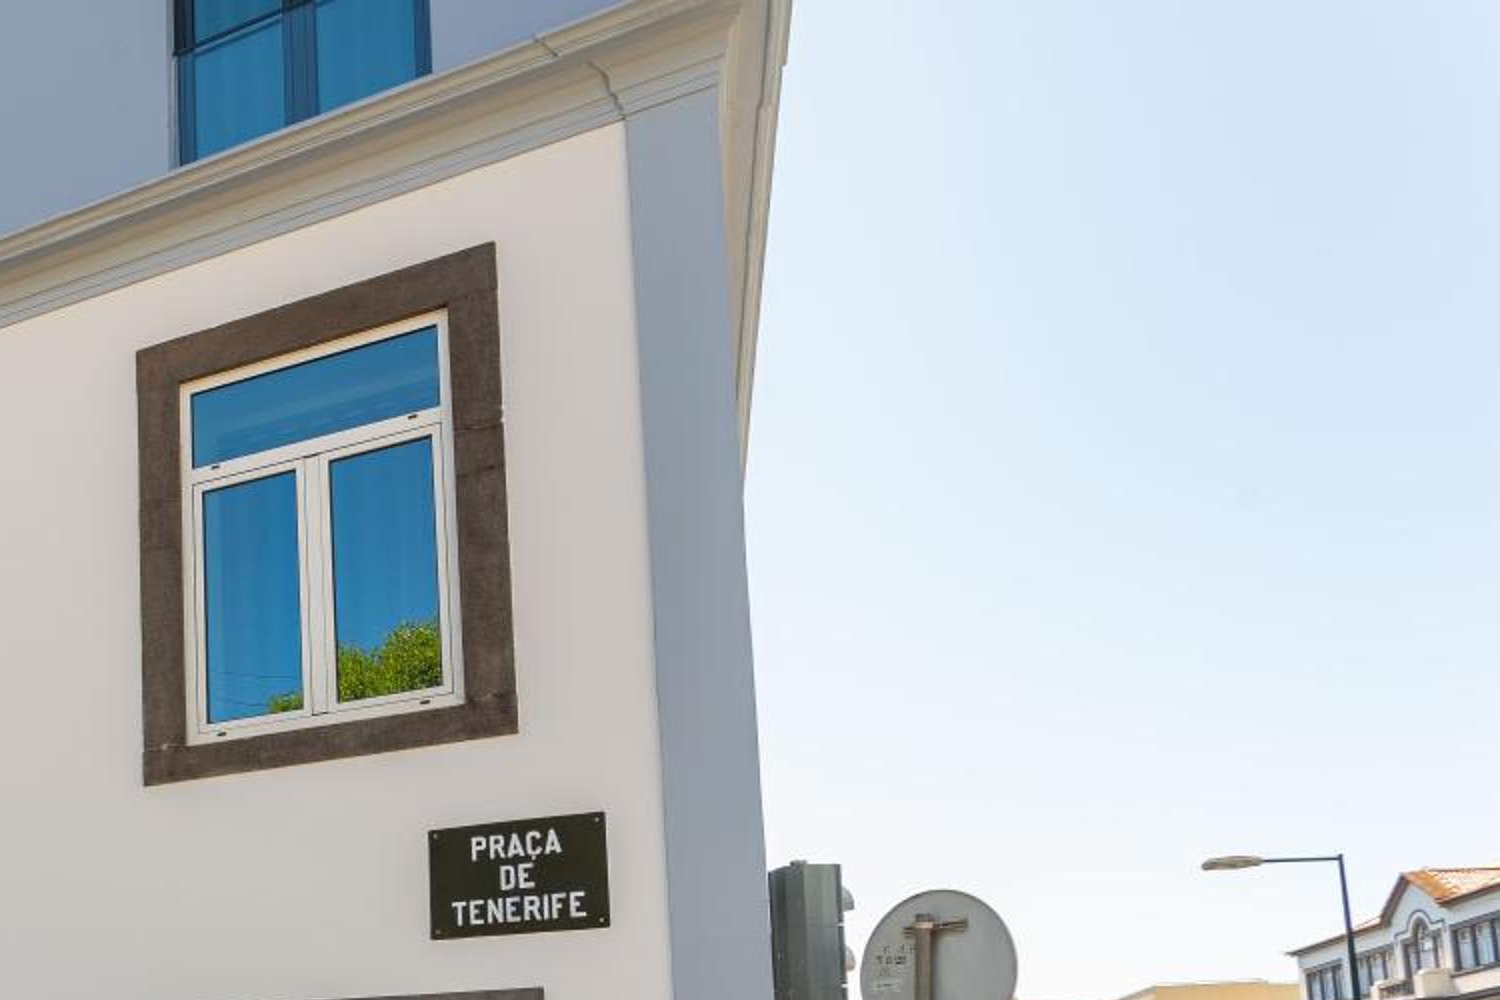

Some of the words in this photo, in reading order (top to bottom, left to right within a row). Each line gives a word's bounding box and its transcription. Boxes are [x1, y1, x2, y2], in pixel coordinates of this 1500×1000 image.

[470, 828, 562, 862] PRAÇA
[499, 862, 536, 891] DE
[451, 891, 587, 927] TENERIFE
